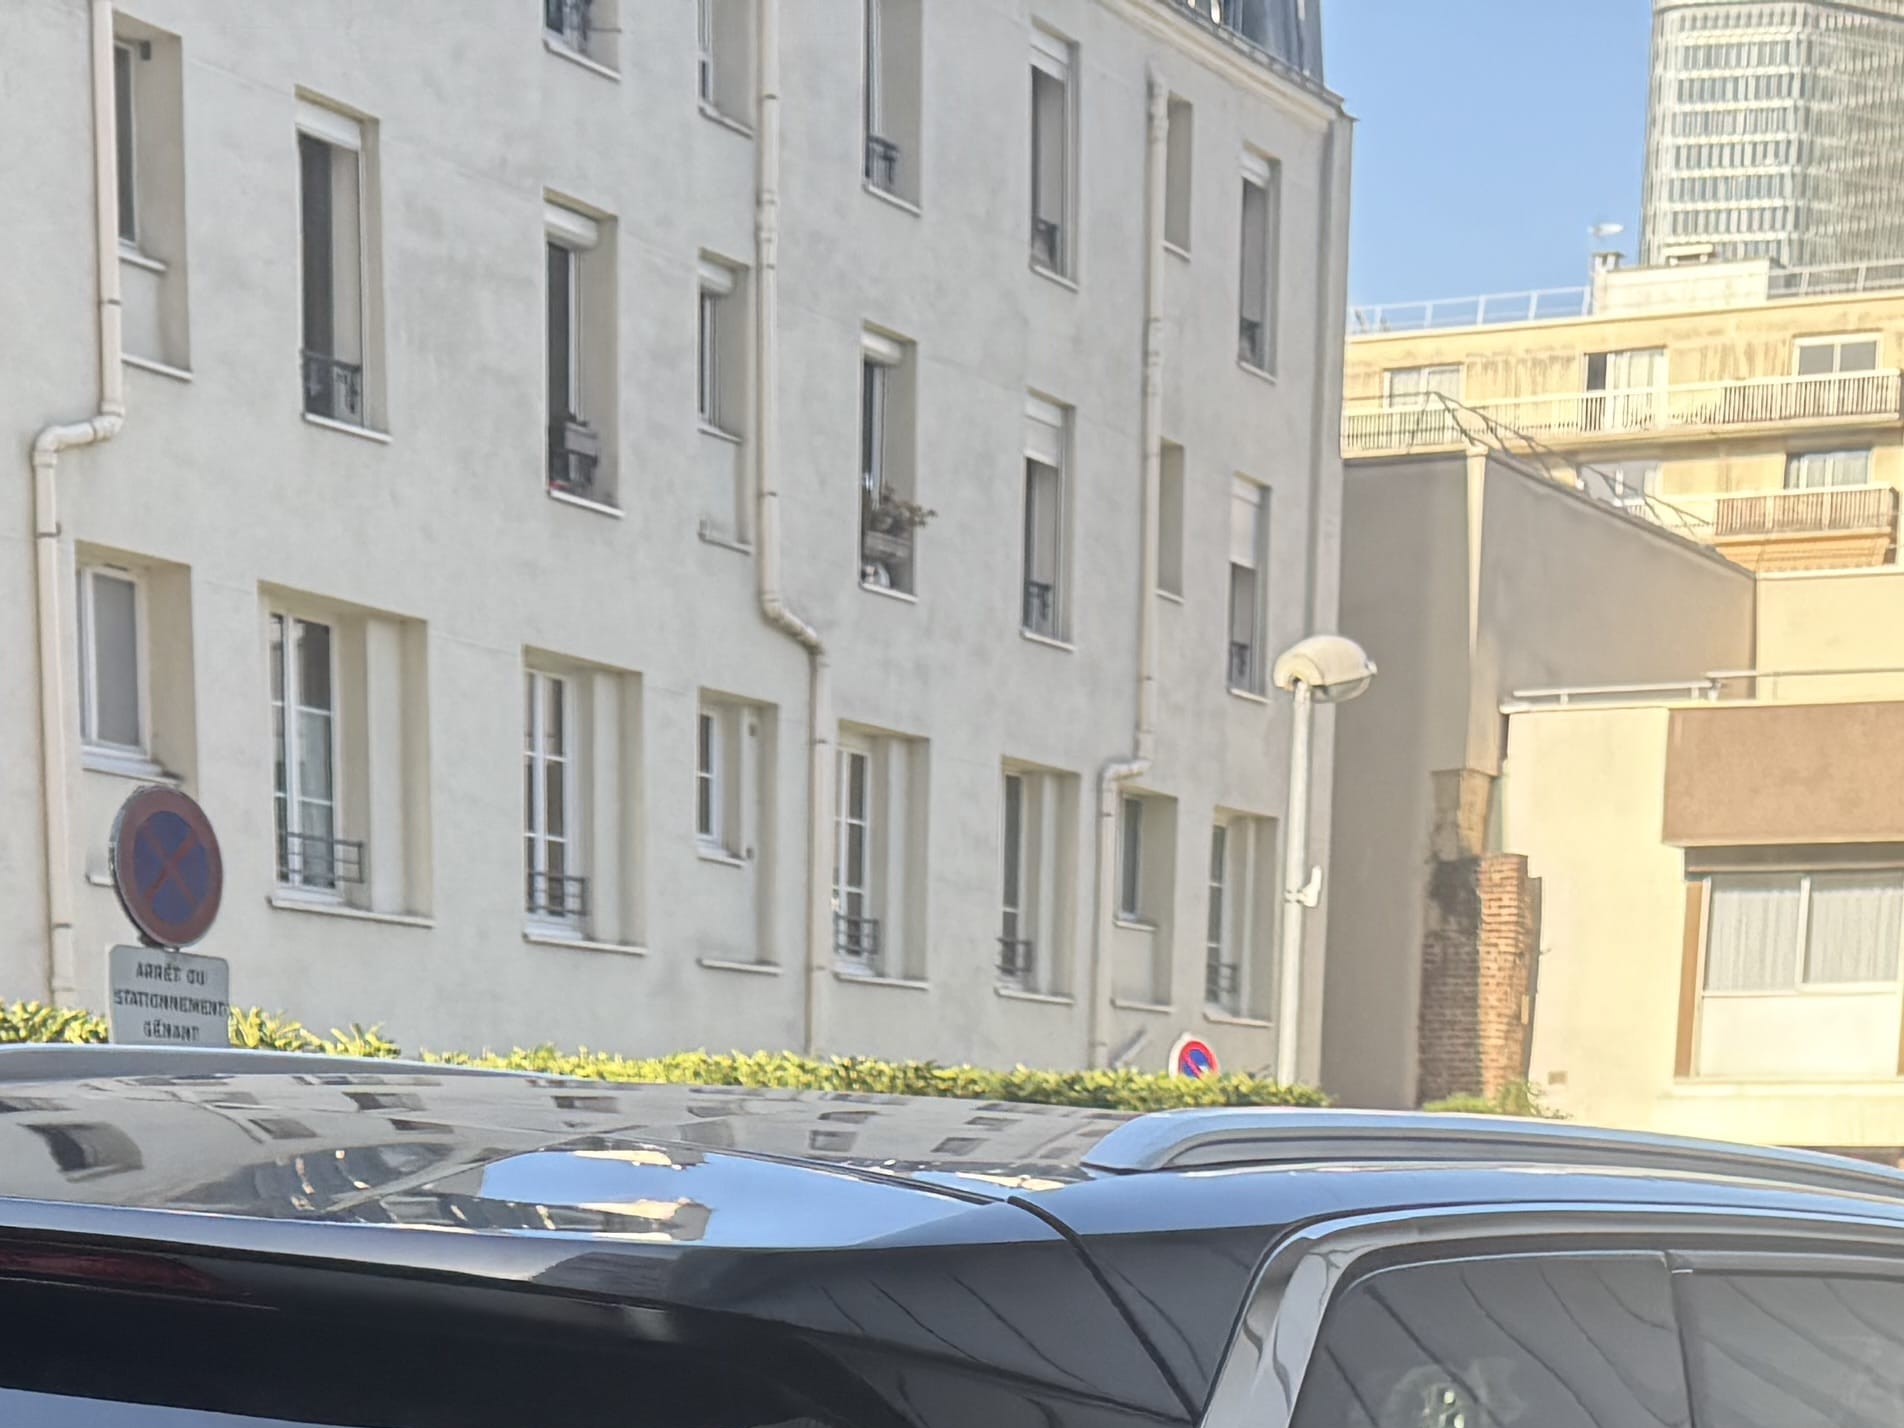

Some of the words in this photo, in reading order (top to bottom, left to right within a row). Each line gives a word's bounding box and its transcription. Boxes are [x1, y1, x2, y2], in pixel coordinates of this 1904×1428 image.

[136, 961, 181, 982] ARRÊT
[187, 968, 206, 986] OU
[113, 988, 229, 1016] STATIONNEMENT
[143, 1018, 200, 1042] GÊNANT
